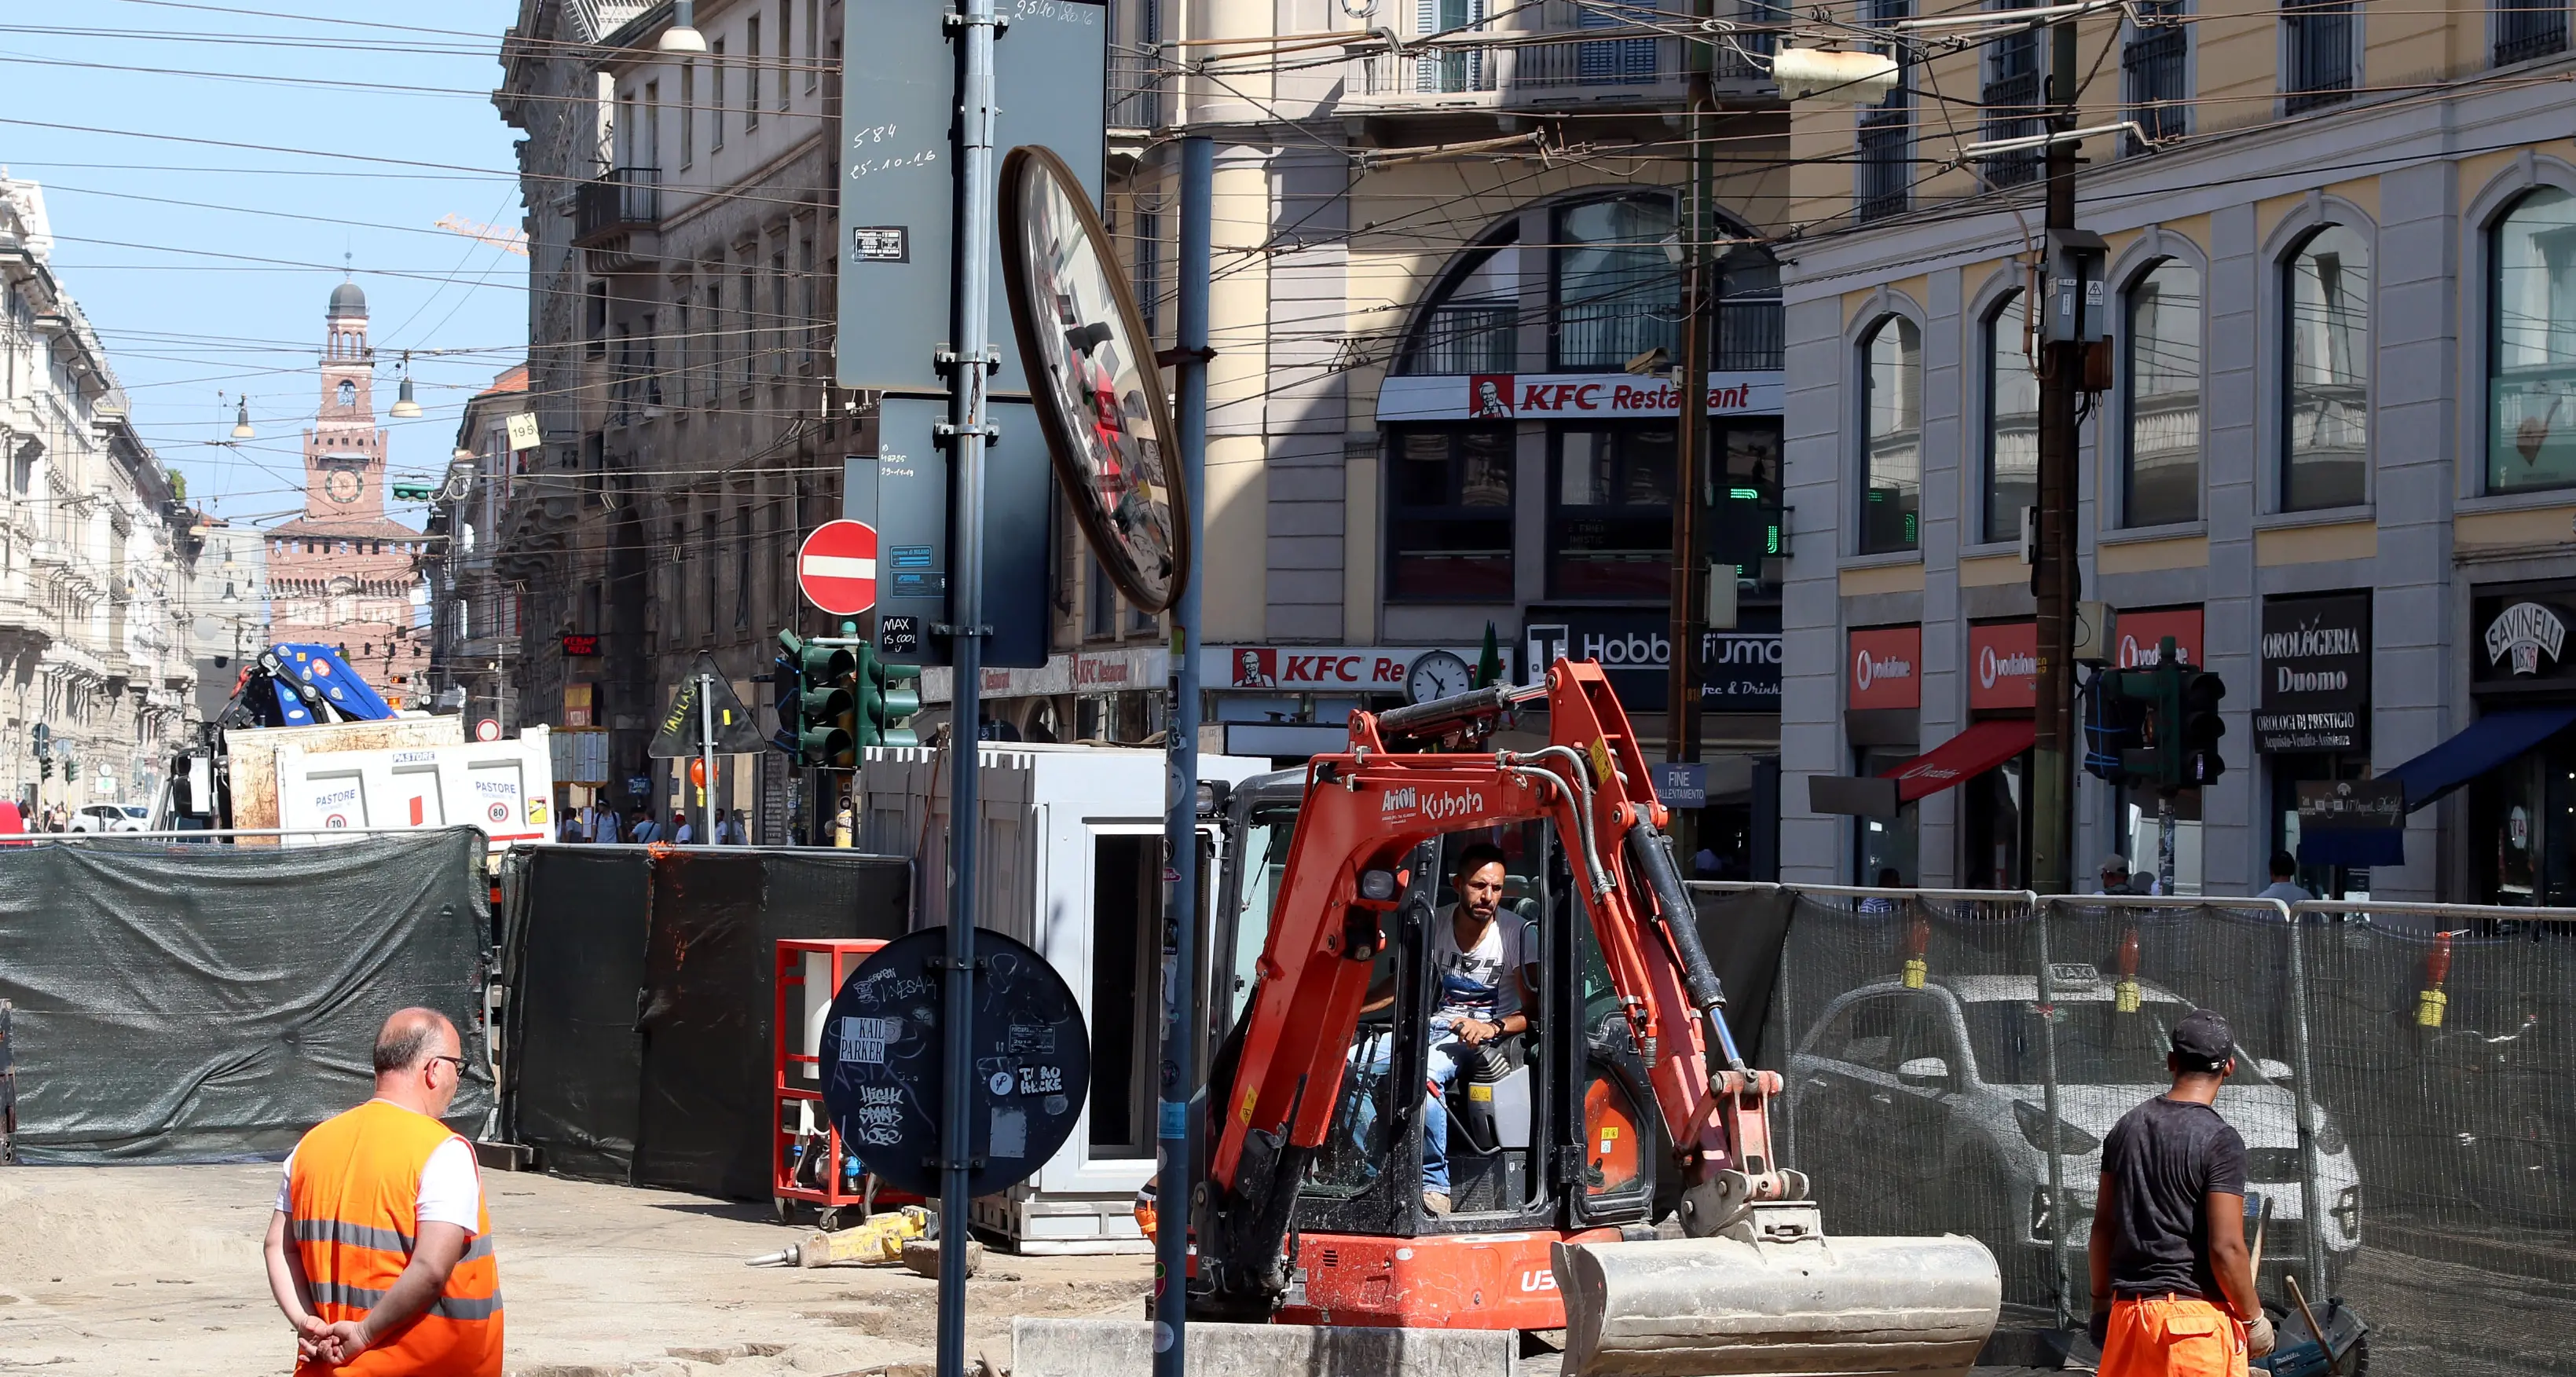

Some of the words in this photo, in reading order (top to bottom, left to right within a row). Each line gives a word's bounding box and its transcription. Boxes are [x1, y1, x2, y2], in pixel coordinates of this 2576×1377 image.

[853, 123, 896, 148] 584
[1521, 384, 1600, 411] KFC
[1612, 383, 1749, 410] Restaant
[513, 424, 535, 439] 195
[882, 617, 909, 633] MAX
[2489, 606, 2562, 658] SAVINELLI
[1584, 632, 1670, 664] Hobb
[2262, 627, 2360, 659] OROLOGERIA
[1282, 656, 1361, 682] KFC
[1872, 654, 1911, 679] vodafone
[1996, 651, 2037, 676] vodafon
[2514, 646, 2536, 669] 1876
[1728, 681, 1738, 694] &
[2277, 666, 2348, 694] Duomo
[2256, 714, 2296, 731] OROLOGI
[2307, 712, 2355, 730] PRESTIGIO
[393, 752, 435, 763] PASTORE
[475, 781, 516, 795] PASTORE
[1668, 771, 1690, 786] FINE
[316, 789, 355, 807] PASTORE
[1421, 786, 1483, 820] Kubota
[493, 808, 504, 818] 80
[841, 1017, 847, 1038] I
[859, 1019, 885, 1039] KAIL
[840, 1040, 883, 1062] PARKER
[1521, 1269, 1559, 1292] U3
